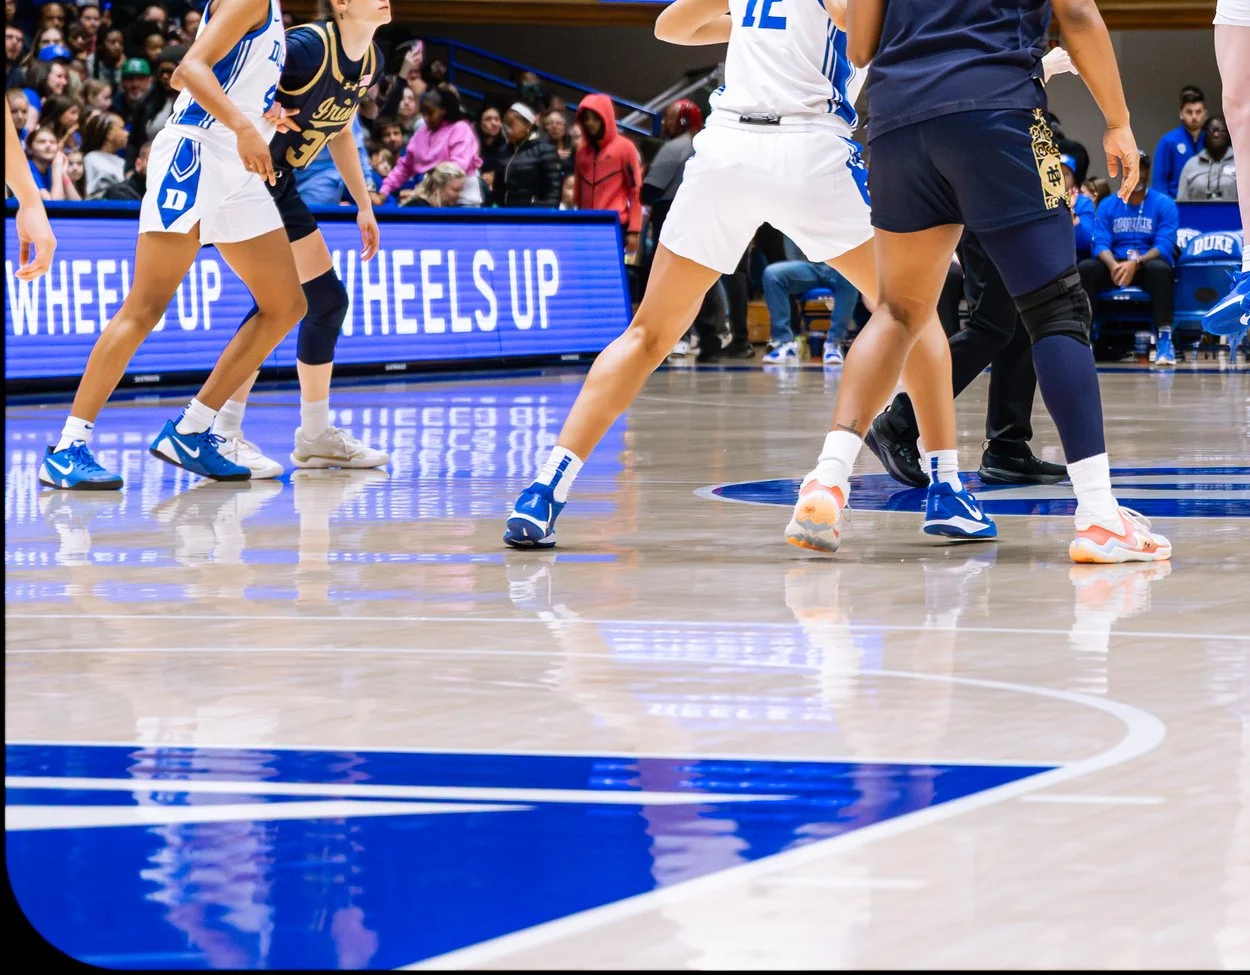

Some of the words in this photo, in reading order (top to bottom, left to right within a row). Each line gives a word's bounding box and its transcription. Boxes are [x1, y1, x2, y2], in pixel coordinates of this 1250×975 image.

[161, 188, 188, 211] D
[1193, 235, 1234, 256] DUKE
[5, 258, 166, 336] WHEE
[176, 258, 221, 331] UP
[508, 249, 560, 330] UP
